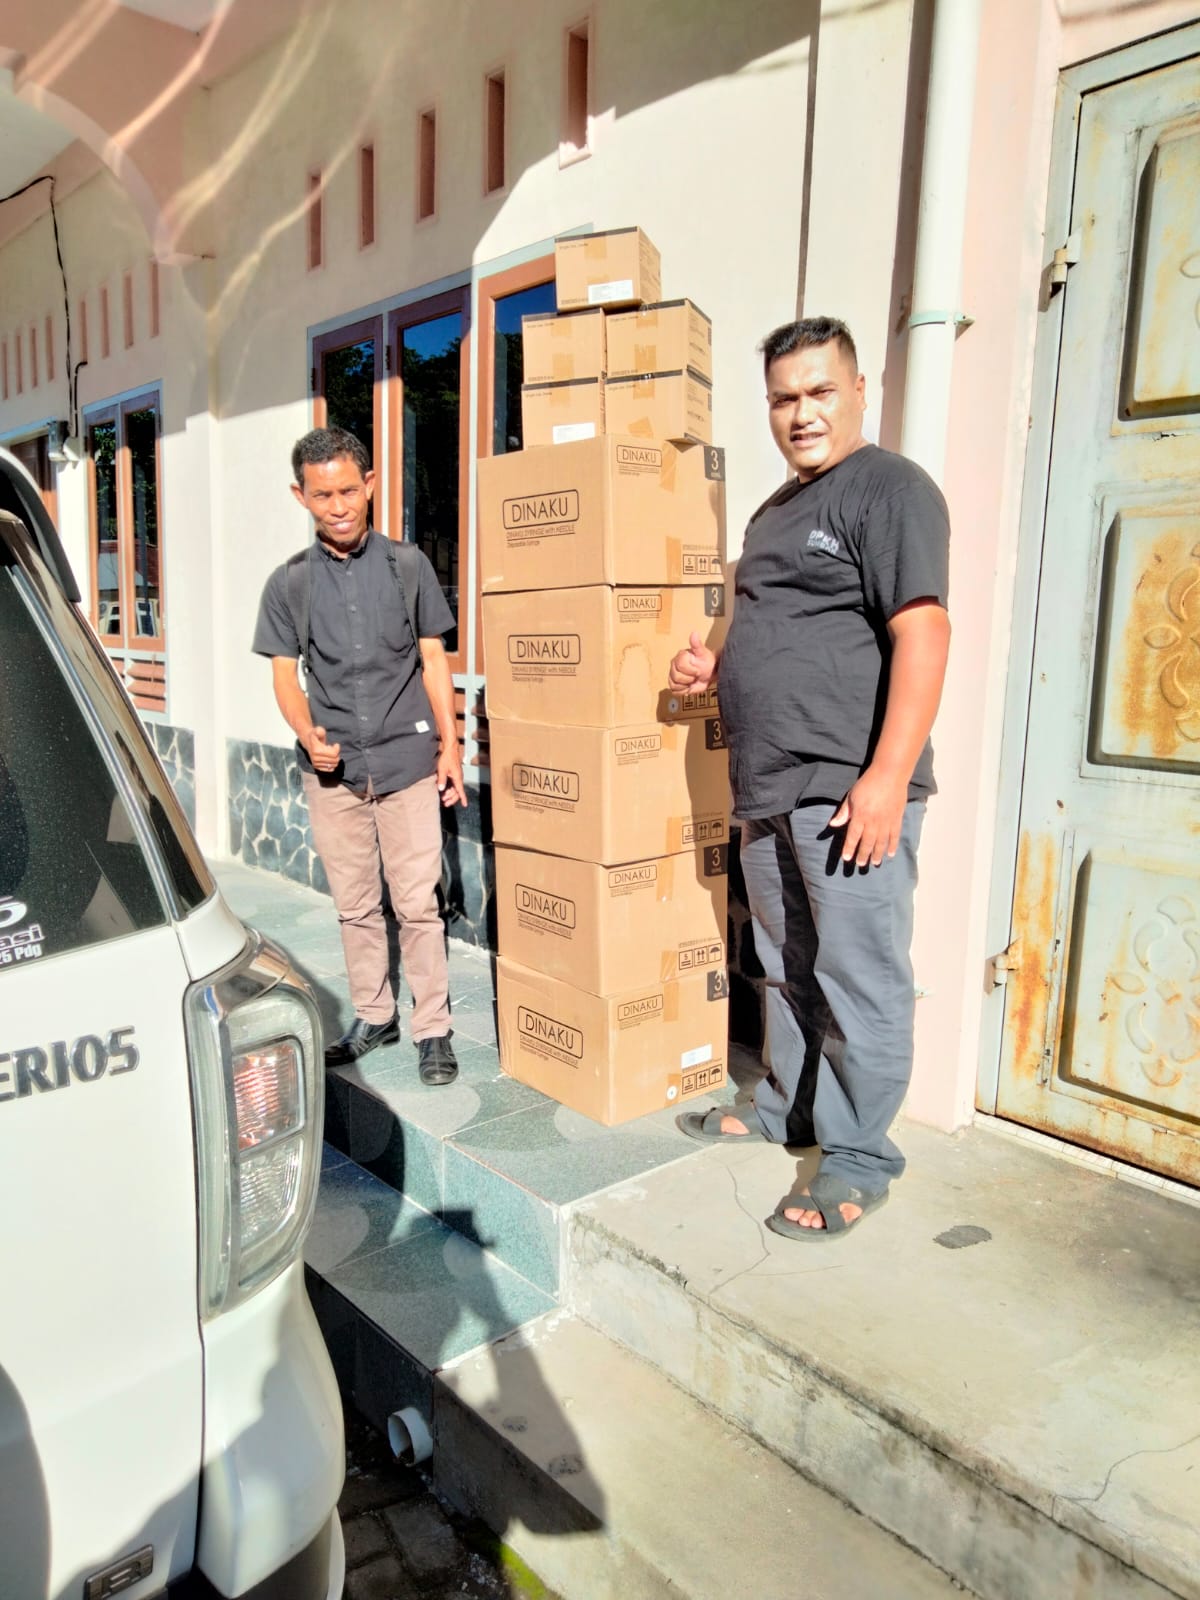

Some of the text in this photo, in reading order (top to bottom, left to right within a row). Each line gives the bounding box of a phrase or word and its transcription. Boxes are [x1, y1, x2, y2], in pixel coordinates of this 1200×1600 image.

[622, 448, 657, 463] DINAKU
[710, 449, 719, 471] 3
[511, 496, 568, 522] DINAKU
[623, 597, 657, 609] DINAKU
[711, 587, 719, 608] 3
[516, 639, 570, 659] DINAKU
[712, 720, 722, 742] 3
[620, 737, 656, 753] DINAKU
[520, 769, 570, 795] DINAKU
[712, 847, 721, 867] 3
[614, 868, 651, 884] DINAKU
[522, 890, 567, 921] DINAKU
[14, 943, 42, 961] Pdg
[714, 970, 722, 991] 3
[623, 998, 658, 1017] DINAKU
[525, 1013, 574, 1049] DINAKU
